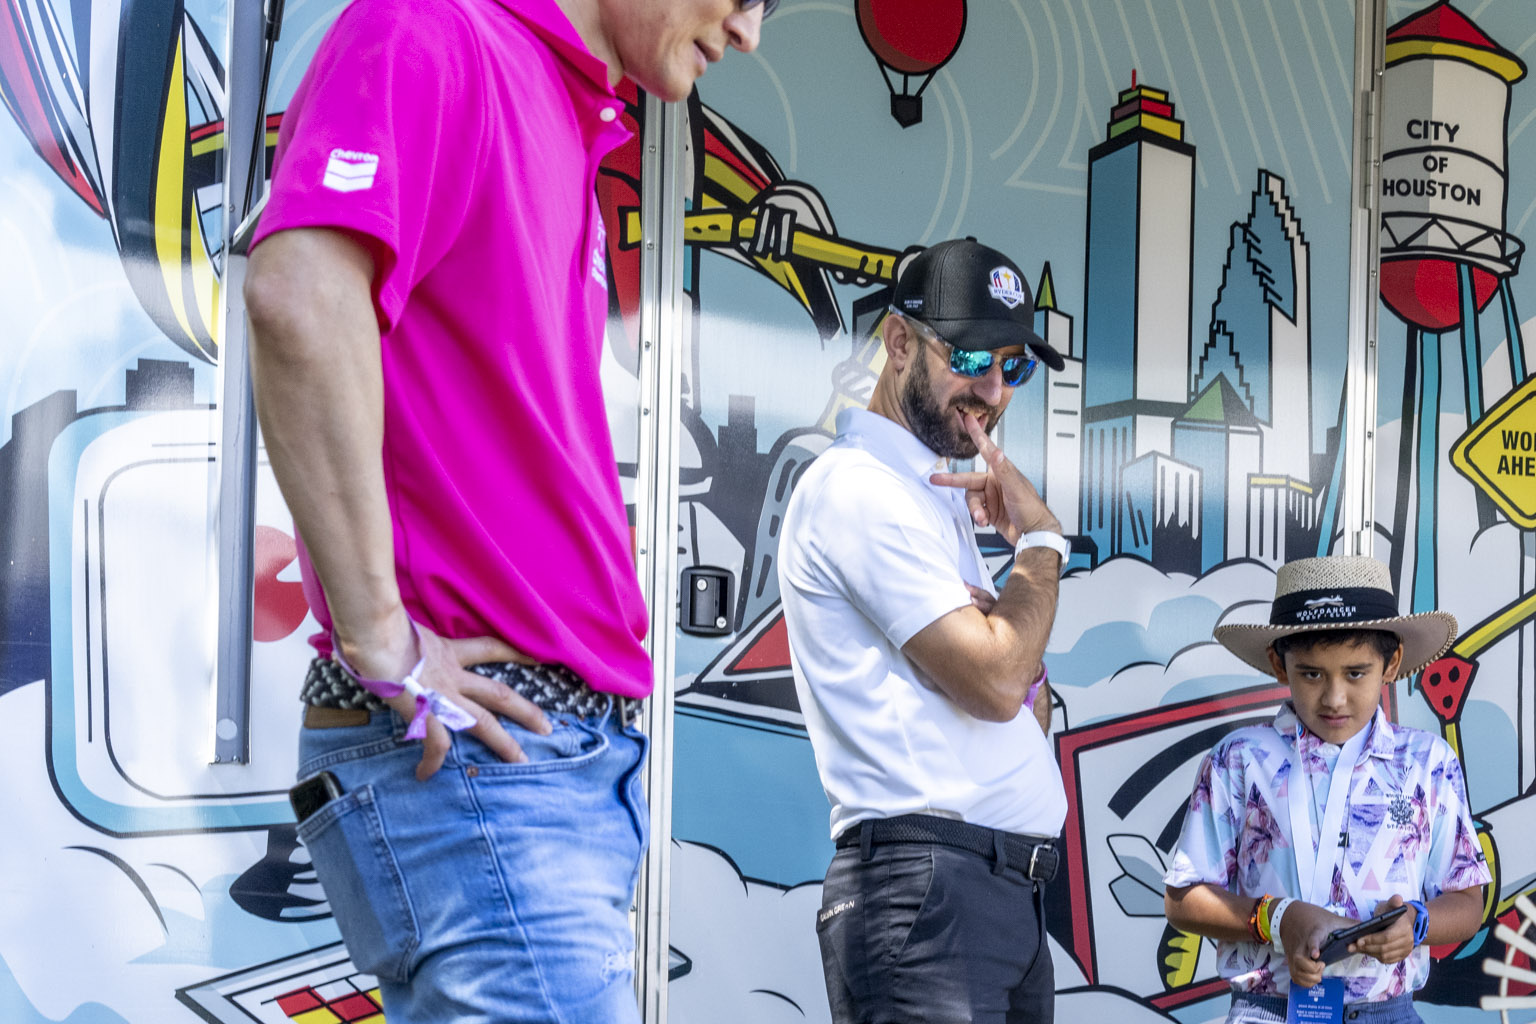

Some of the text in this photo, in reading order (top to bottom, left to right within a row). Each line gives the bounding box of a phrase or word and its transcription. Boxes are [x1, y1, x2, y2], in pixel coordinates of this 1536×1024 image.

[1406, 118, 1460, 142] CITY
[1422, 154, 1449, 173] OF
[1382, 178, 1481, 206] HOUSTON
